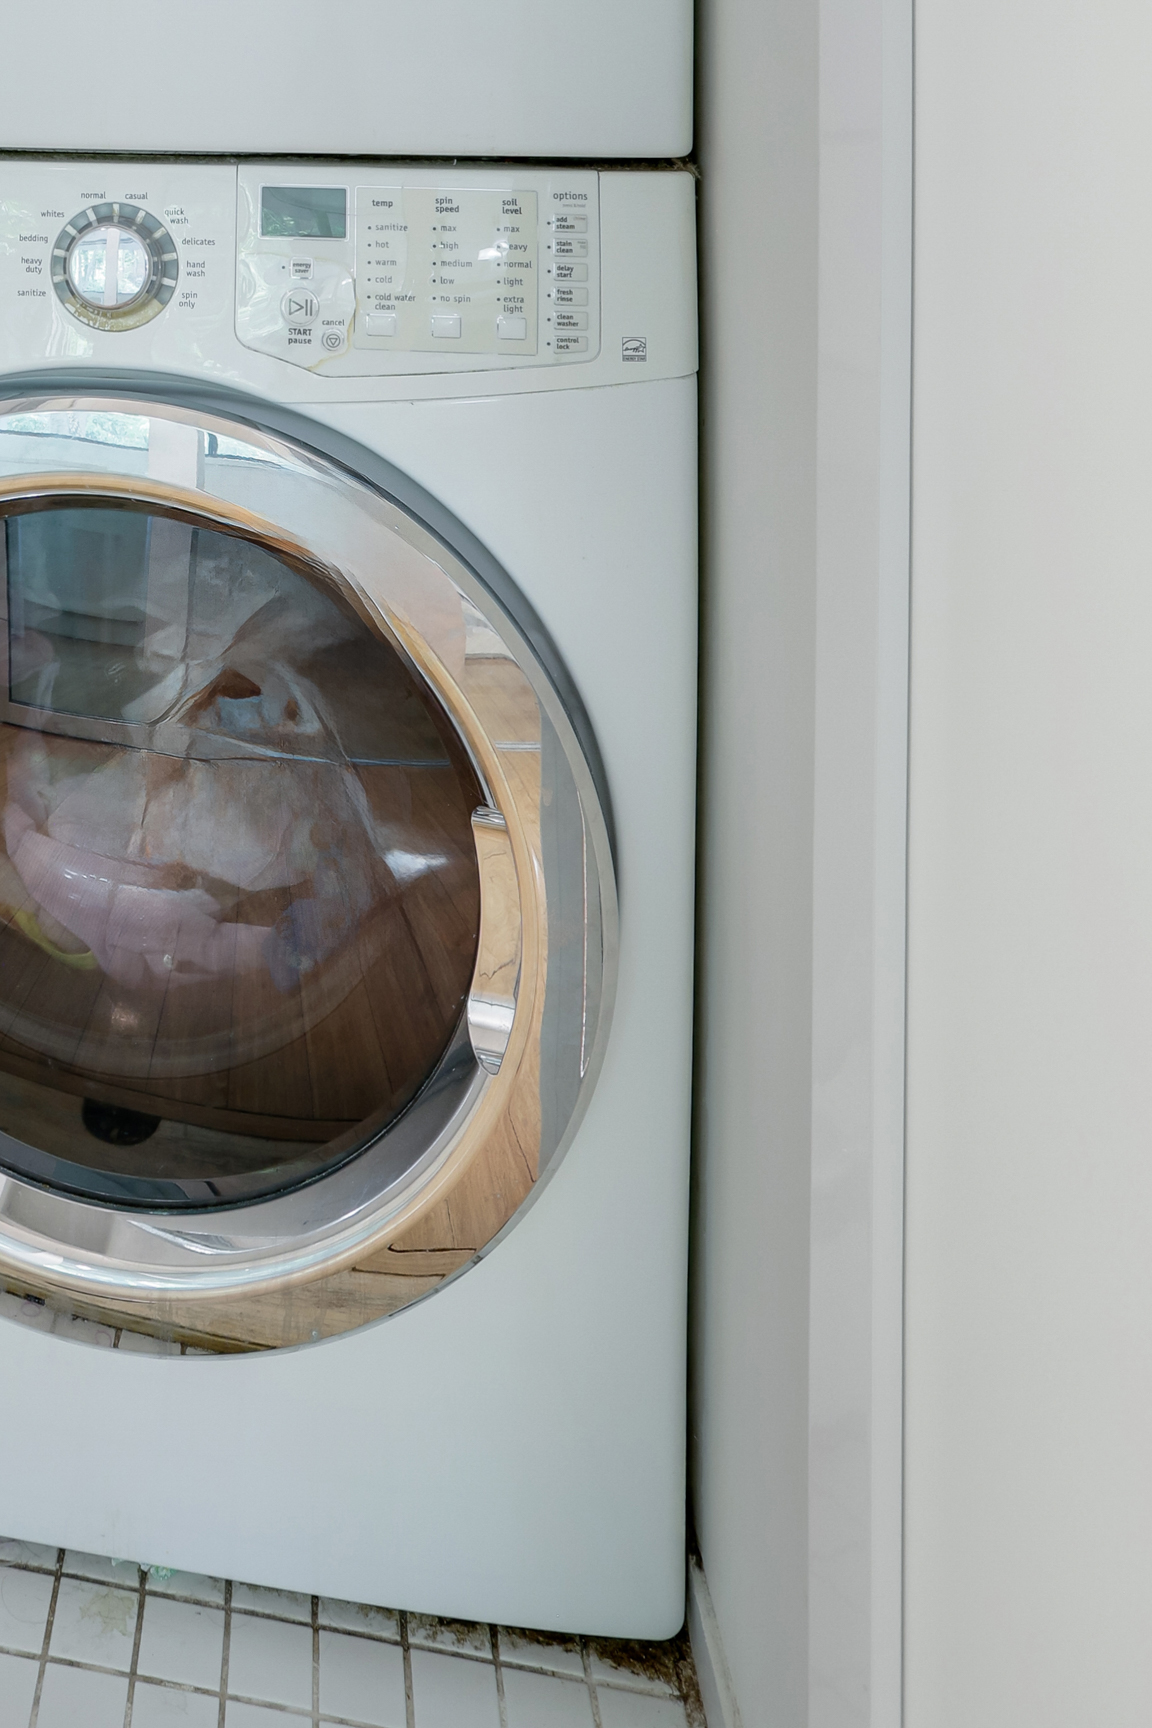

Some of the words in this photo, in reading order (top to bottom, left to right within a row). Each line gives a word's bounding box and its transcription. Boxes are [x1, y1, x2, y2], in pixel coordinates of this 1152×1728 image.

[80, 191, 106, 199] normal
[124, 192, 148, 200] casual
[553, 191, 588, 201] options
[372, 199, 394, 208] temp
[435, 196, 453, 206] spin
[502, 198, 517, 206] soil
[40, 210, 65, 218] whites
[164, 208, 185, 217] quick
[435, 205, 460, 214] speed
[502, 206, 523, 215] level
[170, 216, 189, 224] wash
[375, 223, 408, 232] sanitize
[19, 234, 48, 244] bedding
[181, 237, 216, 246] delicates
[375, 240, 390, 248] hot
[440, 241, 459, 251] high
[507, 243, 528, 252] eavy
[21, 257, 43, 266] heavy
[186, 260, 206, 269] hand
[440, 259, 473, 267] medium
[504, 260, 532, 268] normal
[25, 265, 43, 274] duty
[556, 265, 574, 273] delay
[375, 275, 393, 284] cold
[440, 276, 455, 284] low
[503, 277, 523, 287] light
[17, 289, 47, 297] sanitize
[181, 291, 198, 300] spin
[374, 293, 391, 301] cold
[394, 293, 416, 301] water
[453, 294, 471, 304] spin
[178, 300, 196, 309] only
[374, 302, 396, 310] clean
[503, 304, 523, 314] light
[288, 327, 312, 336] START
[288, 337, 312, 345] pause
